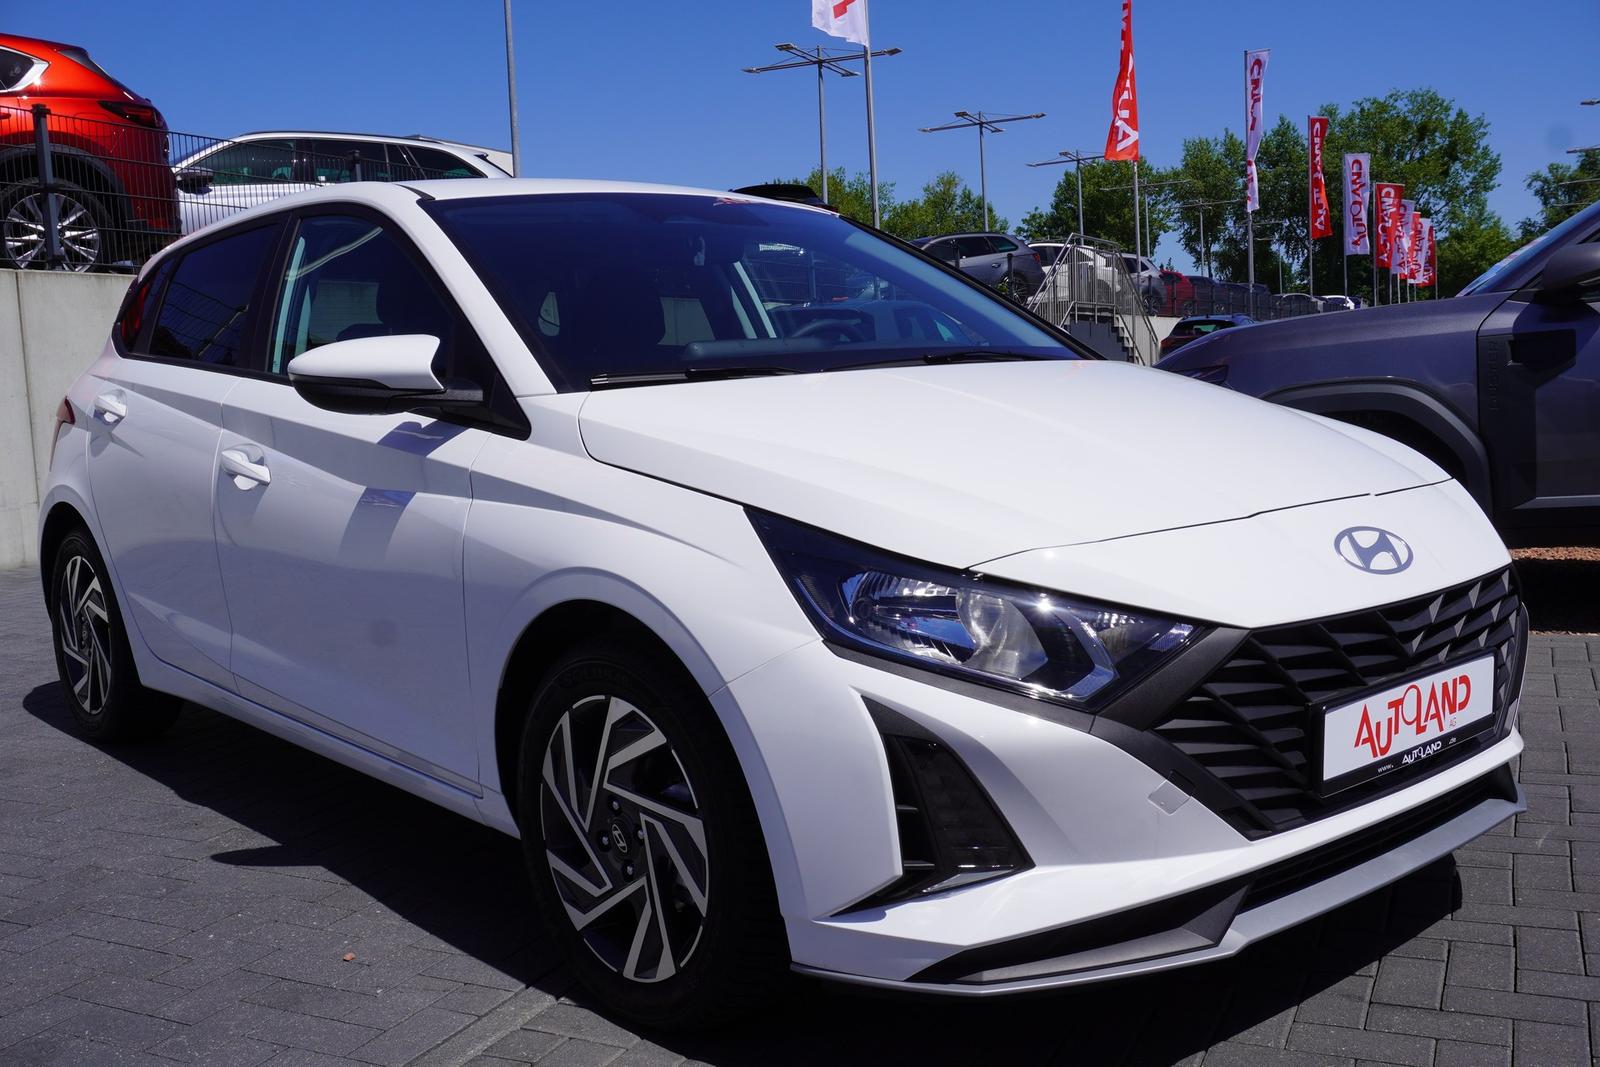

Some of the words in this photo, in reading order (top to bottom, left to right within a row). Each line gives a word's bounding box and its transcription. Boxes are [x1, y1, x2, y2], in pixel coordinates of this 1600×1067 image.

[1349, 159, 1367, 247] AUTOLAND
[1354, 674, 1471, 759] AUTOLAND
[1401, 740, 1442, 765] AUTOLAND
